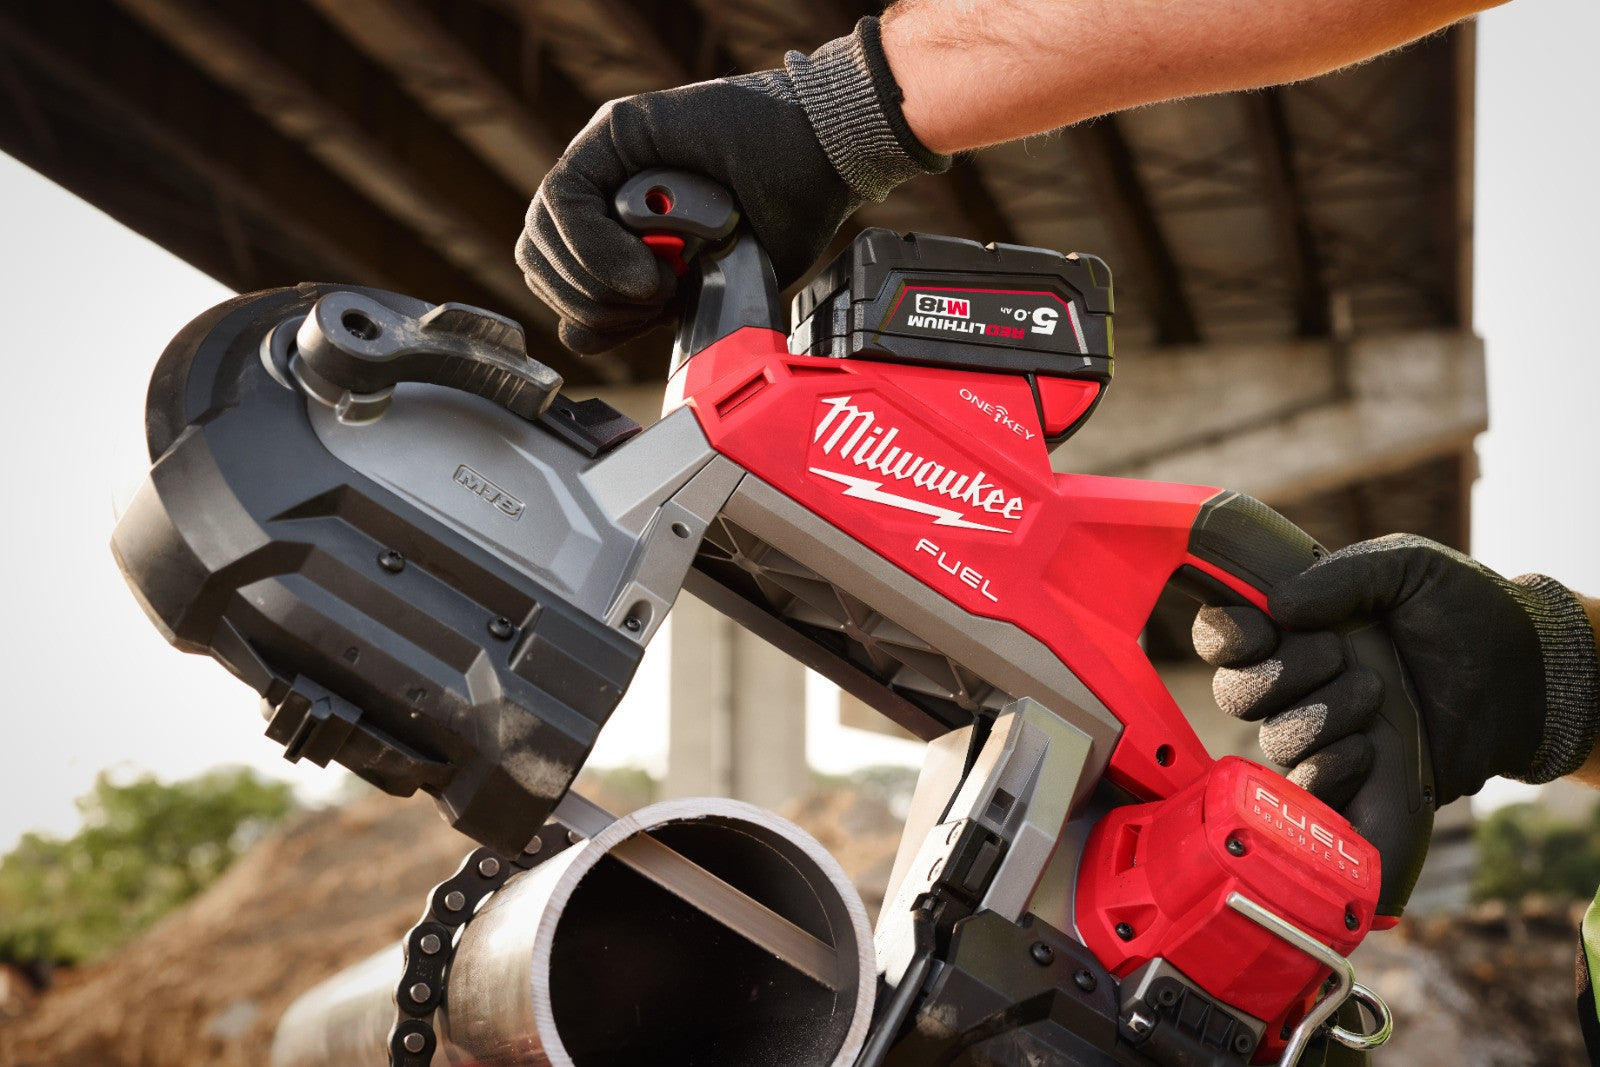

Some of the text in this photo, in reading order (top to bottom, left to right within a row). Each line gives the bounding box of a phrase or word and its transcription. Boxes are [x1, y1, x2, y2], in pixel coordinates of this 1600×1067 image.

[907, 315, 1026, 340] REDLITHIUM
[918, 296, 968, 317] M18
[813, 396, 1024, 520] Milwaukee
[915, 538, 998, 603] FUEL
[1253, 804, 1359, 879] BRUSHLESS
[1255, 787, 1360, 866] FUEL
